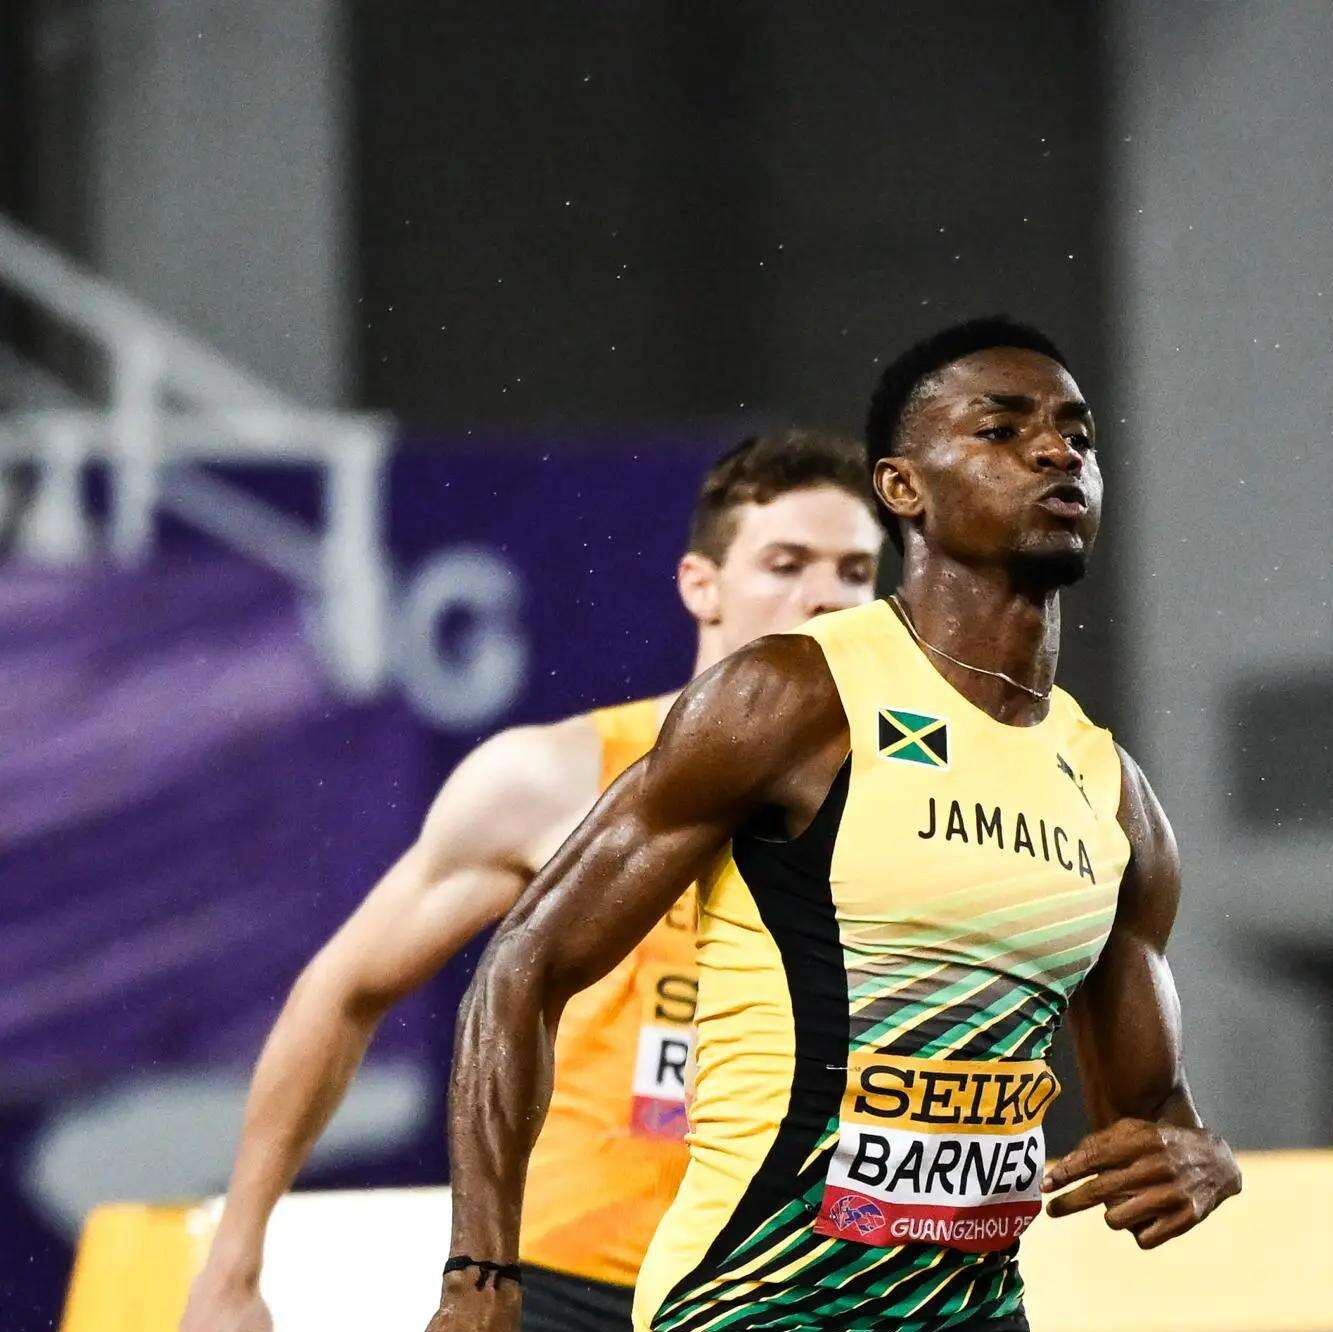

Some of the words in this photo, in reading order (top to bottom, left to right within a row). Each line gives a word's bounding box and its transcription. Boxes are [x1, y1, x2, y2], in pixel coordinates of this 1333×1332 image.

[918, 797, 1096, 885] JAMAICA
[854, 1064, 1056, 1126] SEIKO
[847, 1133, 1038, 1196] BARNES
[890, 1216, 1009, 1241] GUANGZHOU
